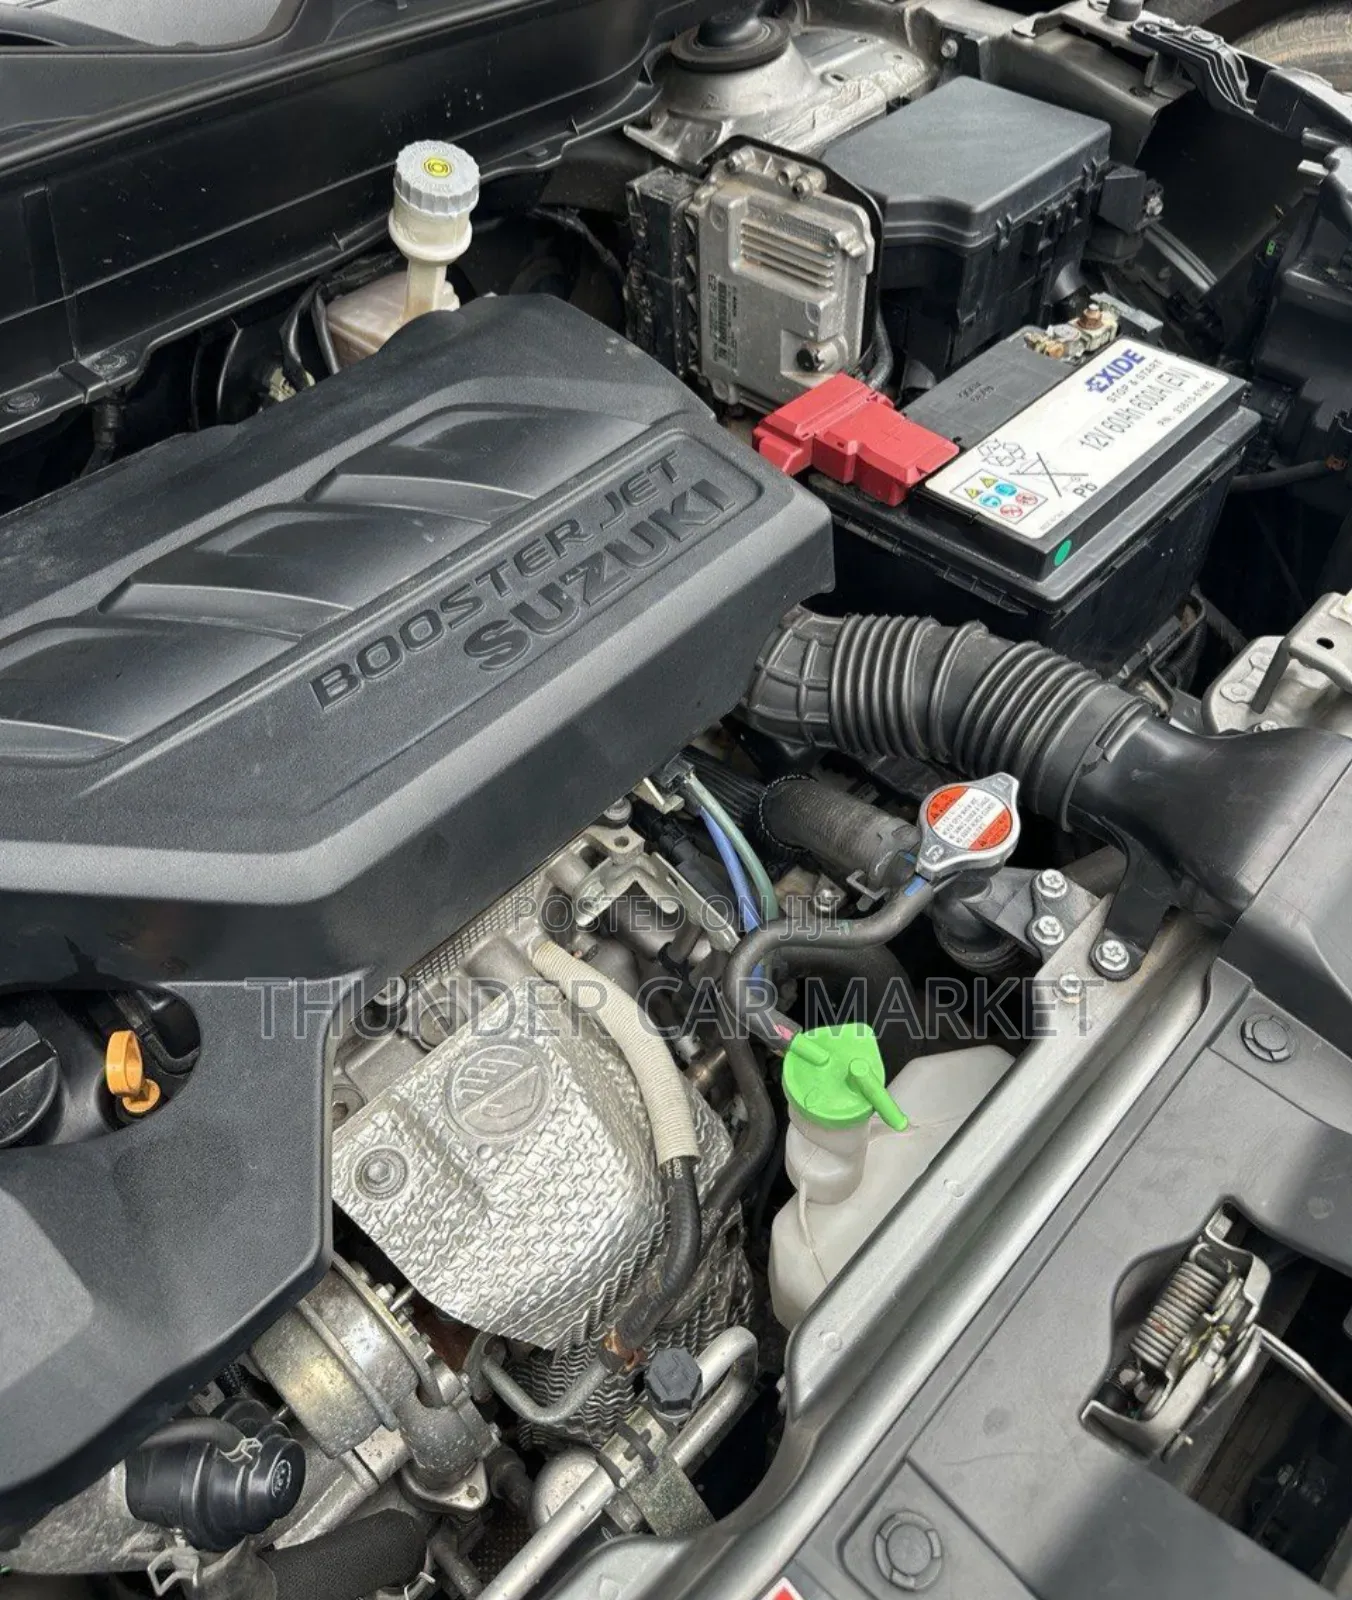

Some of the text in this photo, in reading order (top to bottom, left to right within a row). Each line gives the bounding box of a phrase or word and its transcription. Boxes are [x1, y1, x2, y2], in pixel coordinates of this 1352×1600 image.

[1084, 348, 1146, 393] EXIDE
[1106, 384, 1129, 403] STOP
[1135, 359, 1163, 381] START
[1079, 426, 1115, 451] 12V
[1101, 407, 1146, 433] 60Ah
[1129, 385, 1172, 411] 600A
[1073, 483, 1098, 498] Pb
[310, 451, 680, 711] BOOSTER JET
[463, 479, 737, 671] SUZUKI
